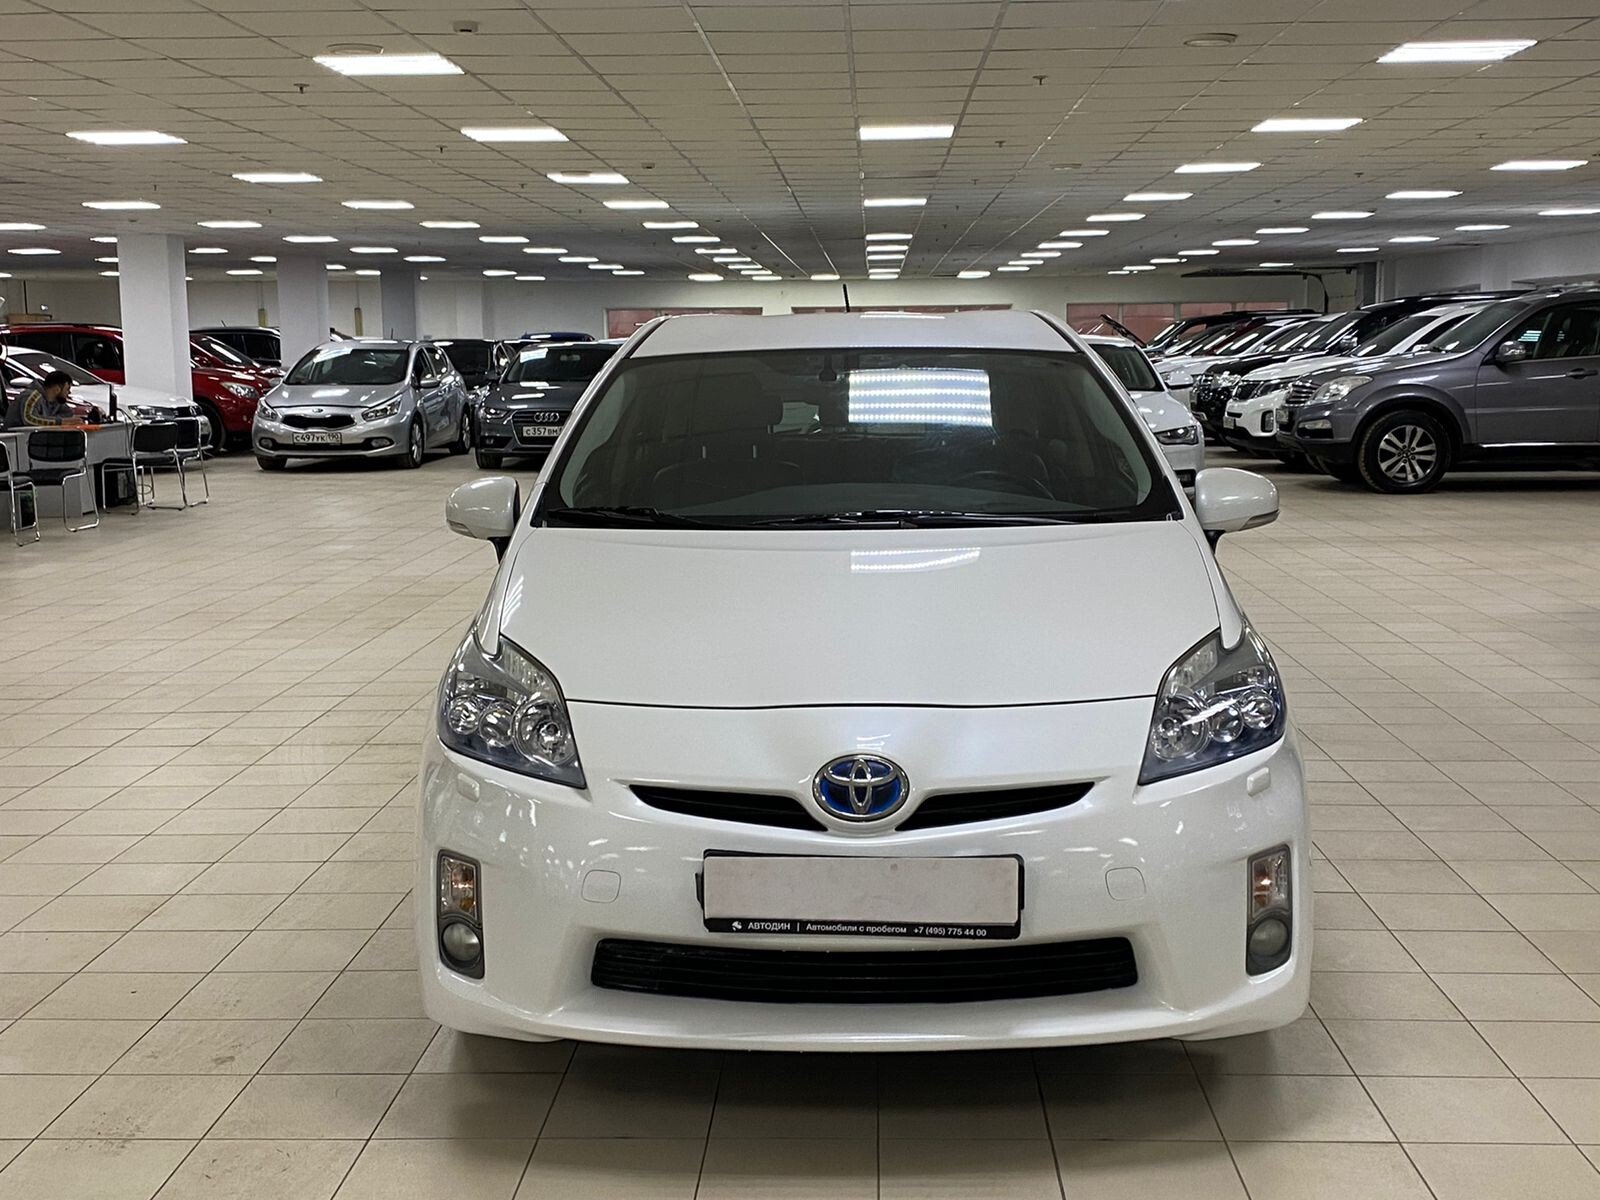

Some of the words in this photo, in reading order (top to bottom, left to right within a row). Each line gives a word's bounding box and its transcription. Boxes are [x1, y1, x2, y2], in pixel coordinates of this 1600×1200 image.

[747, 922, 791, 931] АВТОДИН
[806, 923, 858, 932] Автомобили
[866, 924, 907, 934] пробегом
[913, 926, 924, 934] +7
[925, 926, 946, 935] (495)
[947, 927, 963, 936] 775
[964, 928, 975, 937] 44
[976, 928, 987, 936] 00
